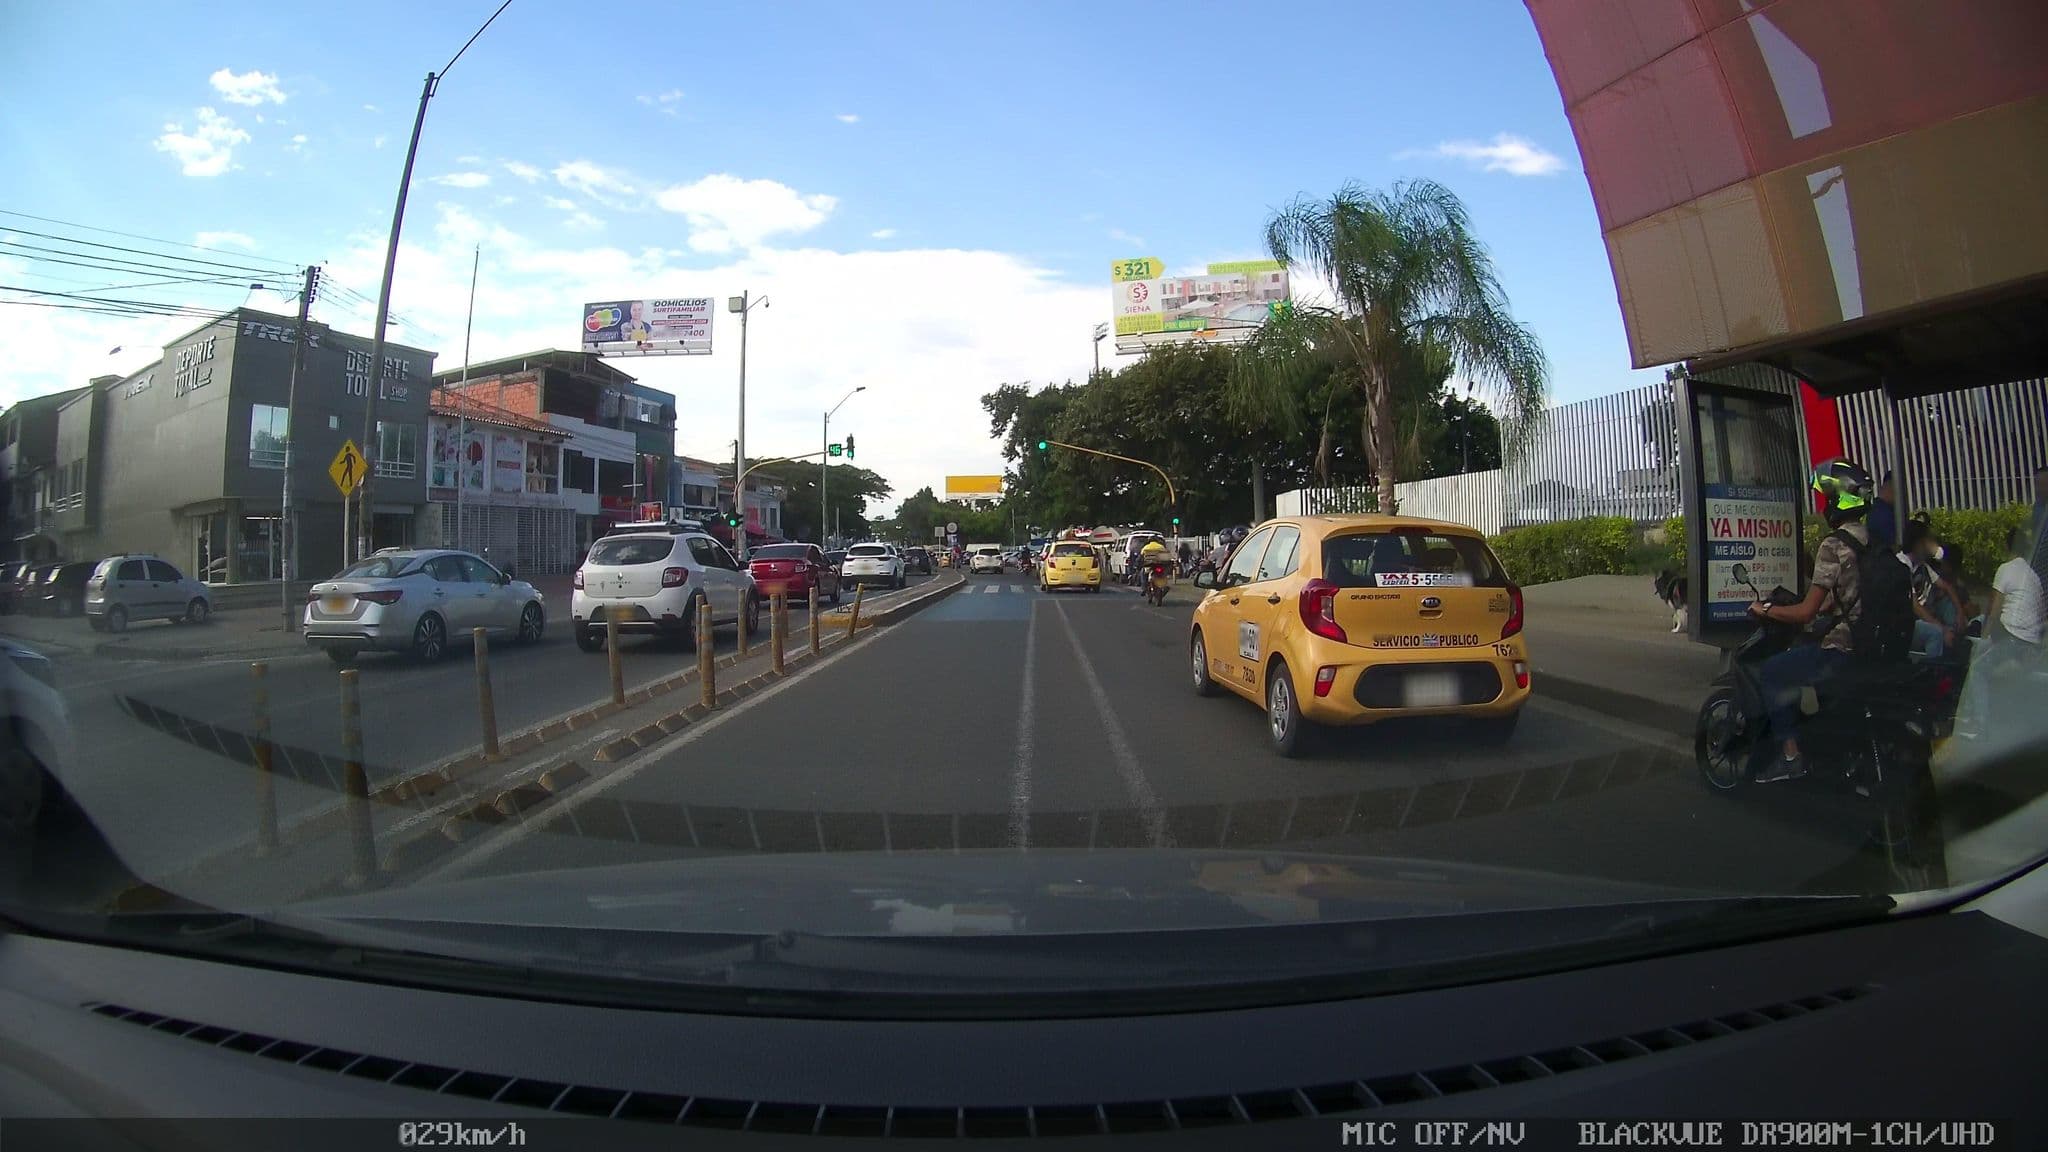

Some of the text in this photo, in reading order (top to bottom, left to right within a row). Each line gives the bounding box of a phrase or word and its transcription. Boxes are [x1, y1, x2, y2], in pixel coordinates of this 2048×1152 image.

[1124, 262, 1150, 277] 321
[653, 306, 706, 314] SURTIFAMILIAR
[654, 299, 707, 307] DOMICILIOS
[1125, 305, 1151, 314] SIENA
[175, 335, 216, 374] DEPORTE
[346, 350, 410, 380] DEPRTE
[174, 367, 200, 398] TOTAL
[346, 372, 387, 400] TOTL
[391, 386, 408, 398] SHOP
[1713, 503, 1733, 515] QUE
[1735, 504, 1747, 515] ME
[1710, 518, 1793, 539] YA MISMO
[1715, 545, 1729, 556] ME
[1729, 542, 1754, 556] AÍSLO
[1758, 547, 1769, 557] en
[1751, 562, 1766, 573] EPS
[1373, 634, 1479, 648] SERVICIO PUBLICO
